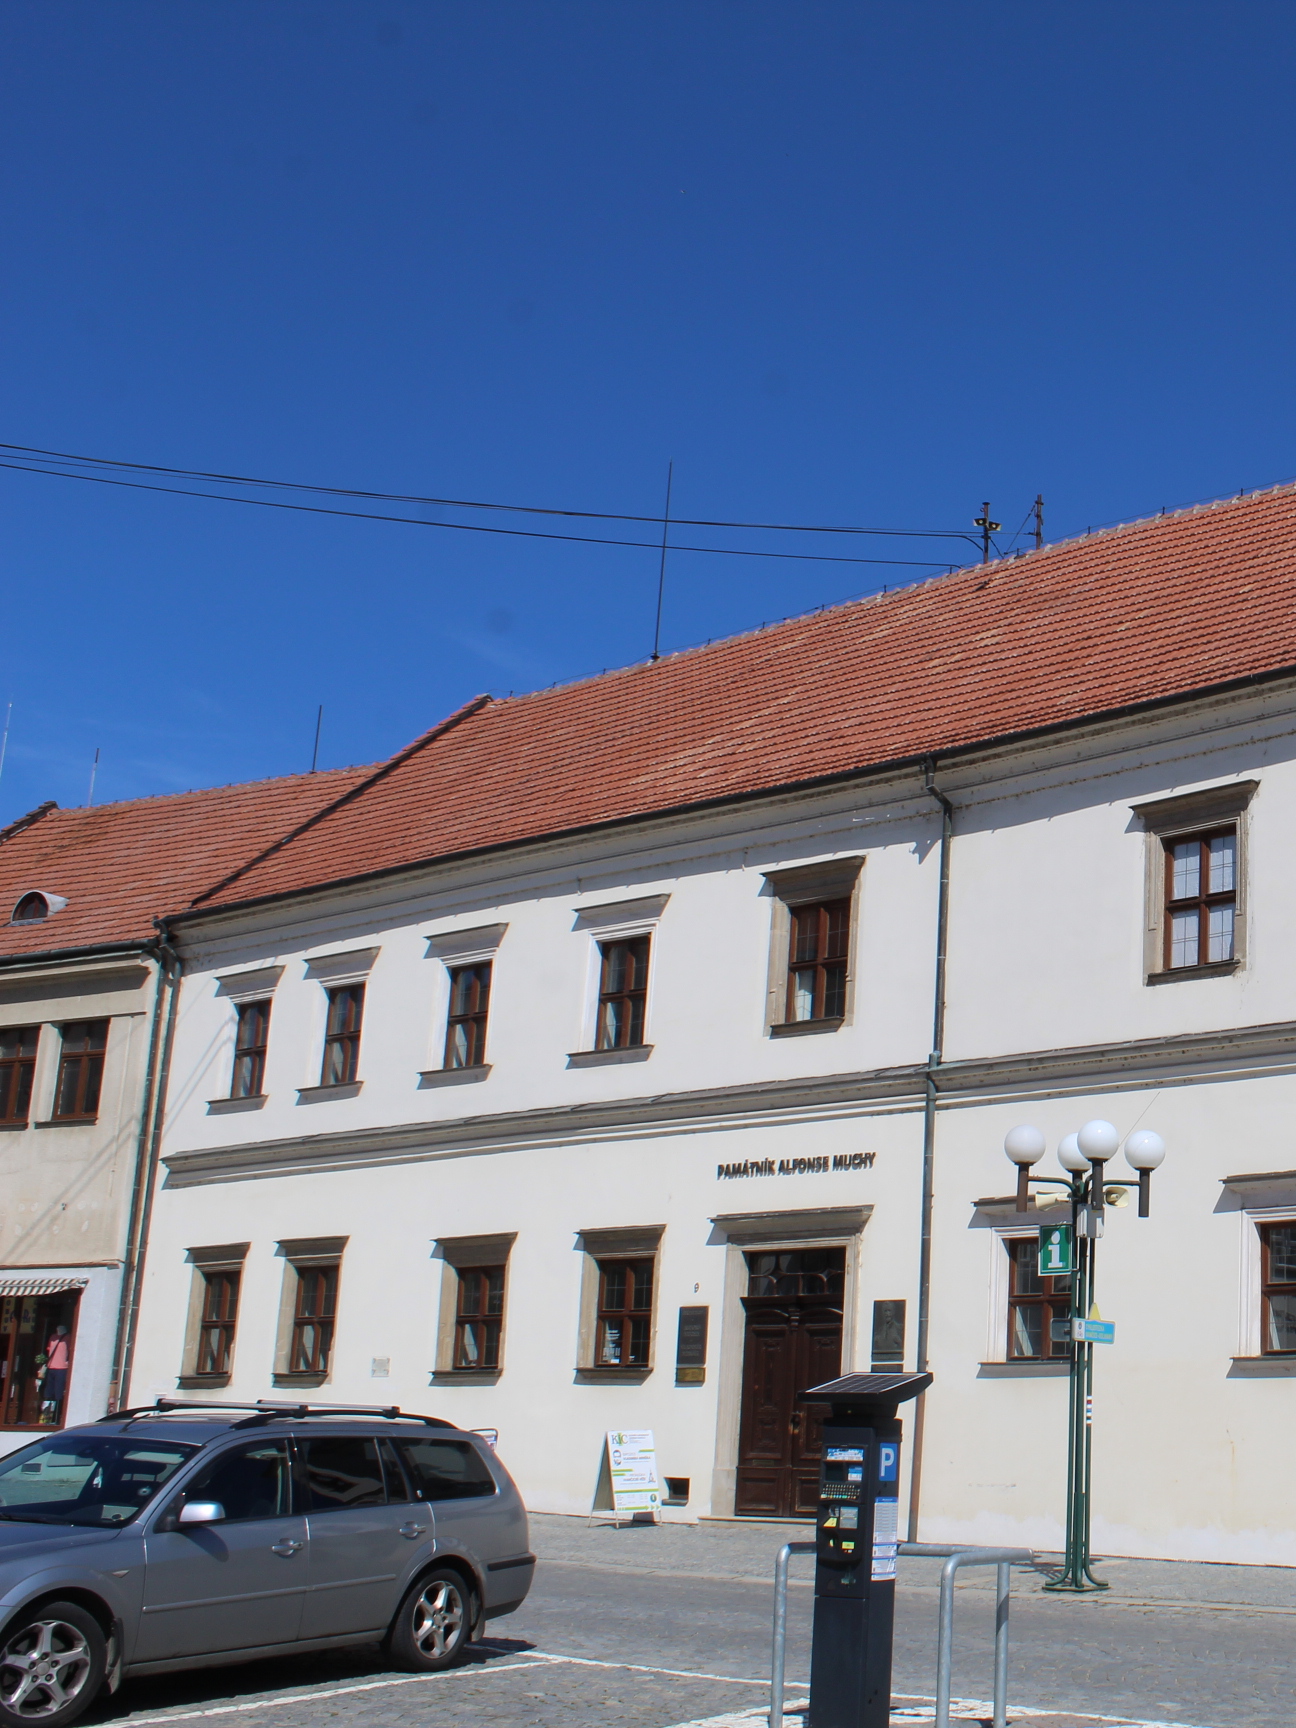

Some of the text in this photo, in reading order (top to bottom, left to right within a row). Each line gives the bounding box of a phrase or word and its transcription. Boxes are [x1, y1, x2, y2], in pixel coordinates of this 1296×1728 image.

[717, 1152, 876, 1180] PAMÁTNÍK ALFONSE MUCHY
[880, 1448, 894, 1476] P
